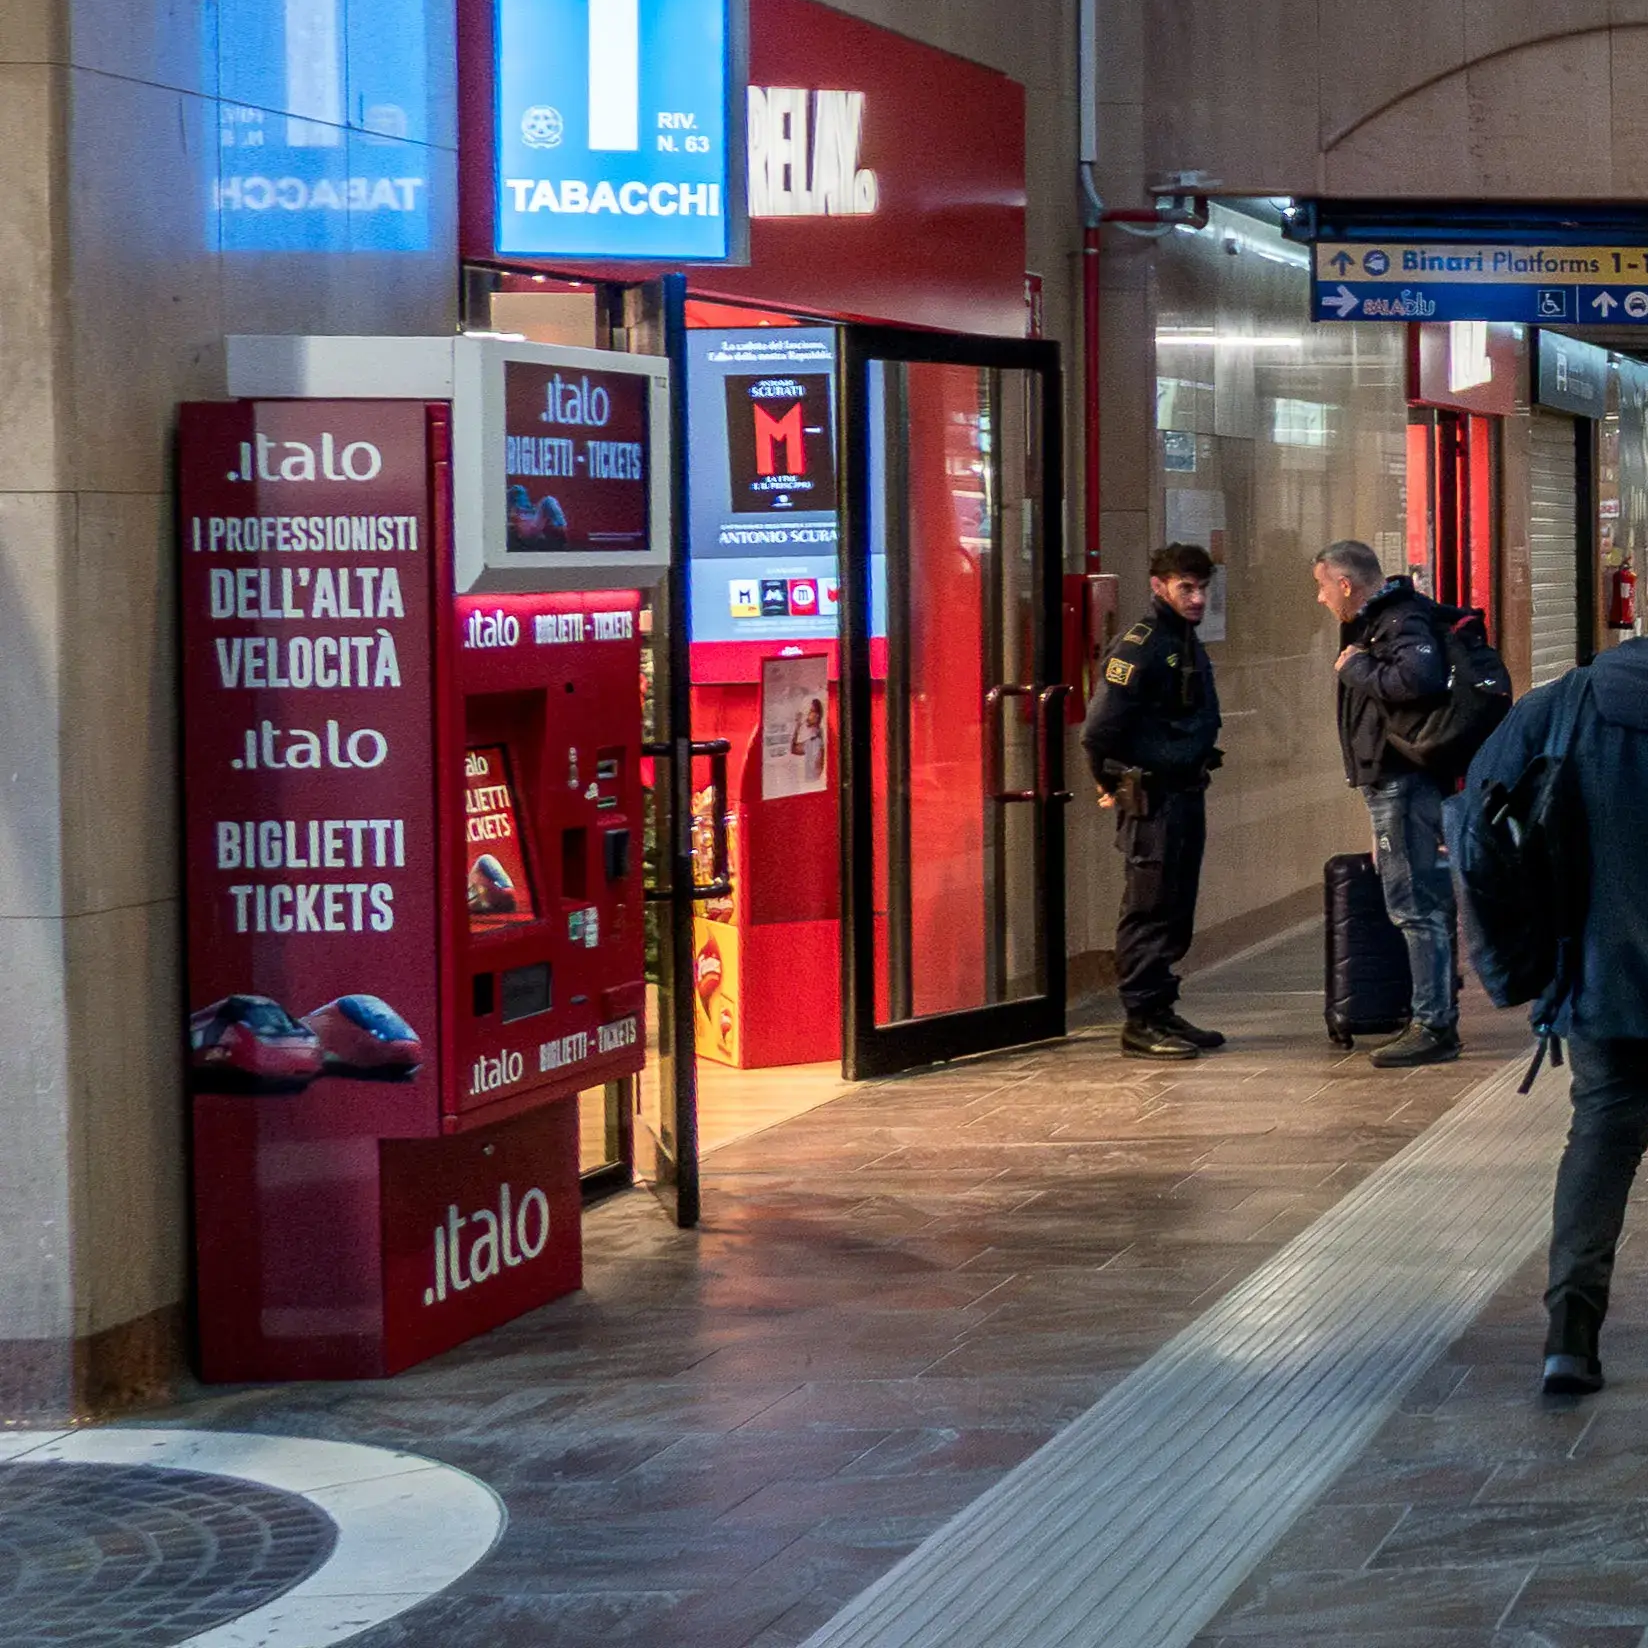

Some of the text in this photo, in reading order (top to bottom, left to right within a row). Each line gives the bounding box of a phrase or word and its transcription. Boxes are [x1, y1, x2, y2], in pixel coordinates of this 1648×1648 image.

[656, 111, 698, 130] RIV.
[656, 136, 710, 153] N. 63
[506, 177, 721, 217] TABACCHI
[1402, 249, 1483, 272] Binari
[1492, 251, 1599, 274] Platforms
[506, 435, 574, 477] BIGLIETTI
[587, 440, 642, 480] TICKETS
[753, 402, 806, 475] M
[192, 516, 419, 552] I PROFESSIONISTI
[719, 529, 838, 544] ANTONIO SCURA
[592, 611, 633, 641] TICKETS
[215, 627, 402, 690] VELOCITÀ
[216, 818, 406, 870] BIGLIETTI
[229, 882, 395, 934] TICKETS
[596, 1016, 638, 1054] TICKETS
